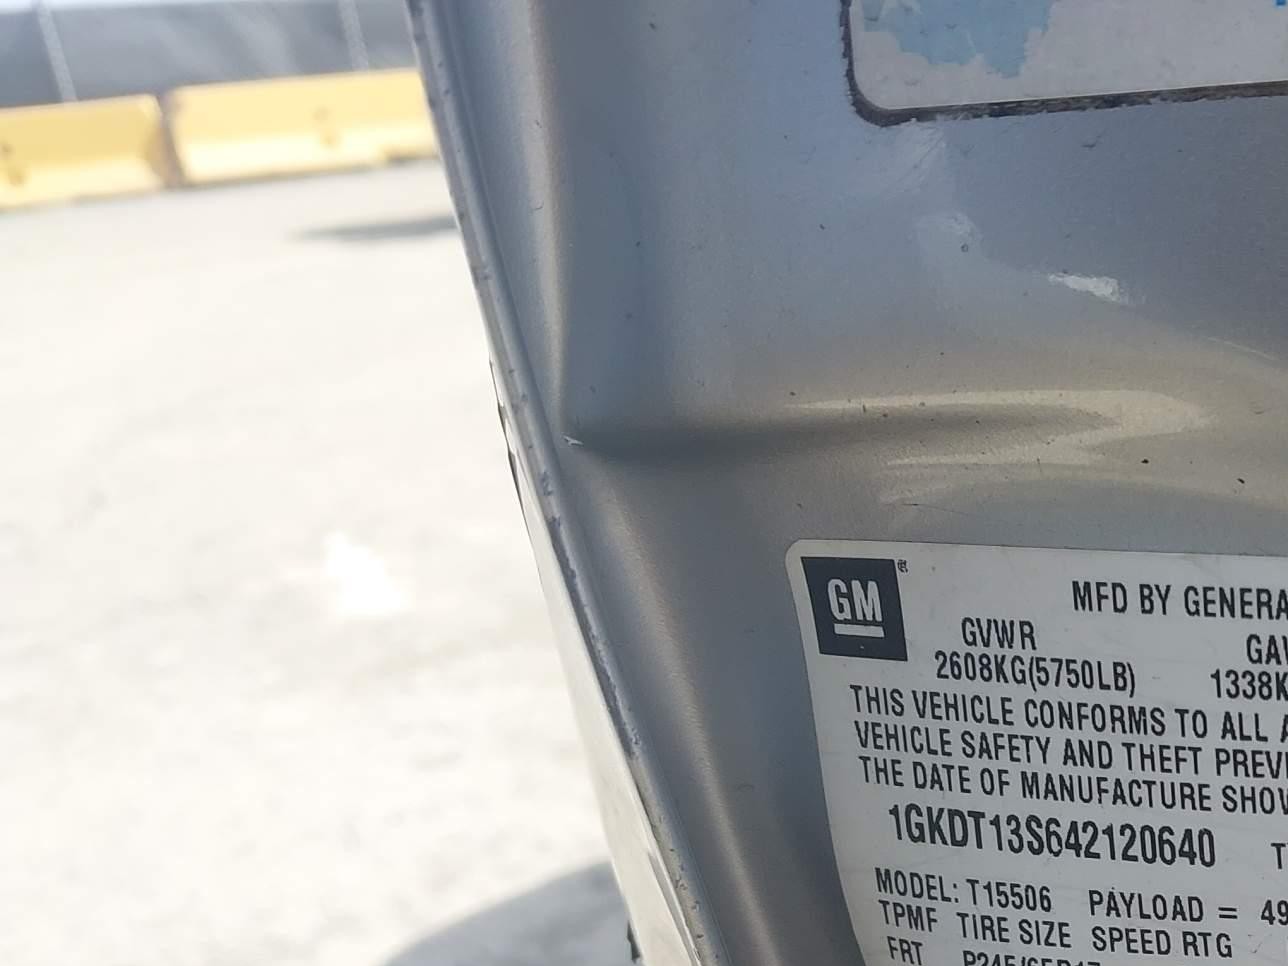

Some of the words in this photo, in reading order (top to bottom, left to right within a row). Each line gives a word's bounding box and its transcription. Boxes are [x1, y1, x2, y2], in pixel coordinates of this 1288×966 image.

[1072, 581, 1127, 614] MFD
[1139, 584, 1171, 615] BY
[961, 617, 1037, 651] GVWR
[935, 650, 1135, 698] 2608KG(5750LB)
[850, 684, 904, 717] THIS
[911, 690, 1014, 726] VEHICLE
[1024, 699, 1166, 736] CONFORMS
[1174, 708, 1207, 738] TO
[1221, 711, 1268, 742] ALL
[854, 720, 952, 757] VEHICLE
[961, 730, 1050, 764] SAFETY
[1063, 738, 1113, 769] AND
[1121, 742, 1202, 775] THEFT
[858, 756, 904, 787] THE
[912, 761, 972, 793] DATE
[980, 768, 1010, 796] OF
[1020, 771, 1212, 811] MANUFACTURE
[889, 803, 1215, 868] 1GKDT13S642120640
[875, 867, 959, 903] MODEL:
[966, 879, 1051, 912] T15506
[1089, 890, 1204, 922] PAYLOAD
[878, 899, 938, 932] TPMF
[956, 912, 1010, 943] TIRE
[1018, 919, 1072, 948] SIZE
[1091, 926, 1171, 955] SPEED
[1182, 931, 1232, 958] RTG
[887, 936, 923, 966] FRT
